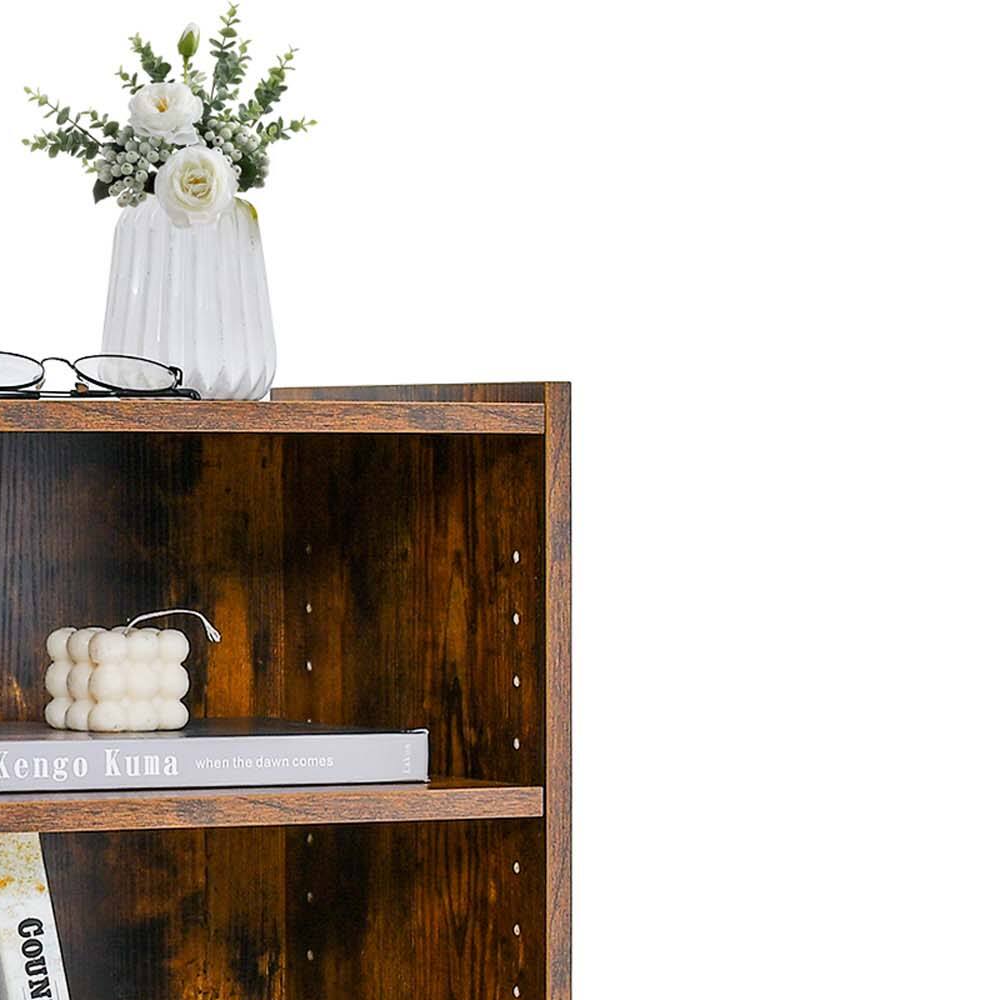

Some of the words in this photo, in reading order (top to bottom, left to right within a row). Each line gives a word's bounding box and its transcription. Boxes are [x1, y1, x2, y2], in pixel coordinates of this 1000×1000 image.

[105, 748, 178, 777] Kuma
[195, 756, 230, 769] when
[232, 755, 253, 769] the
[255, 755, 290, 769] dawn
[292, 755, 334, 767] comes
